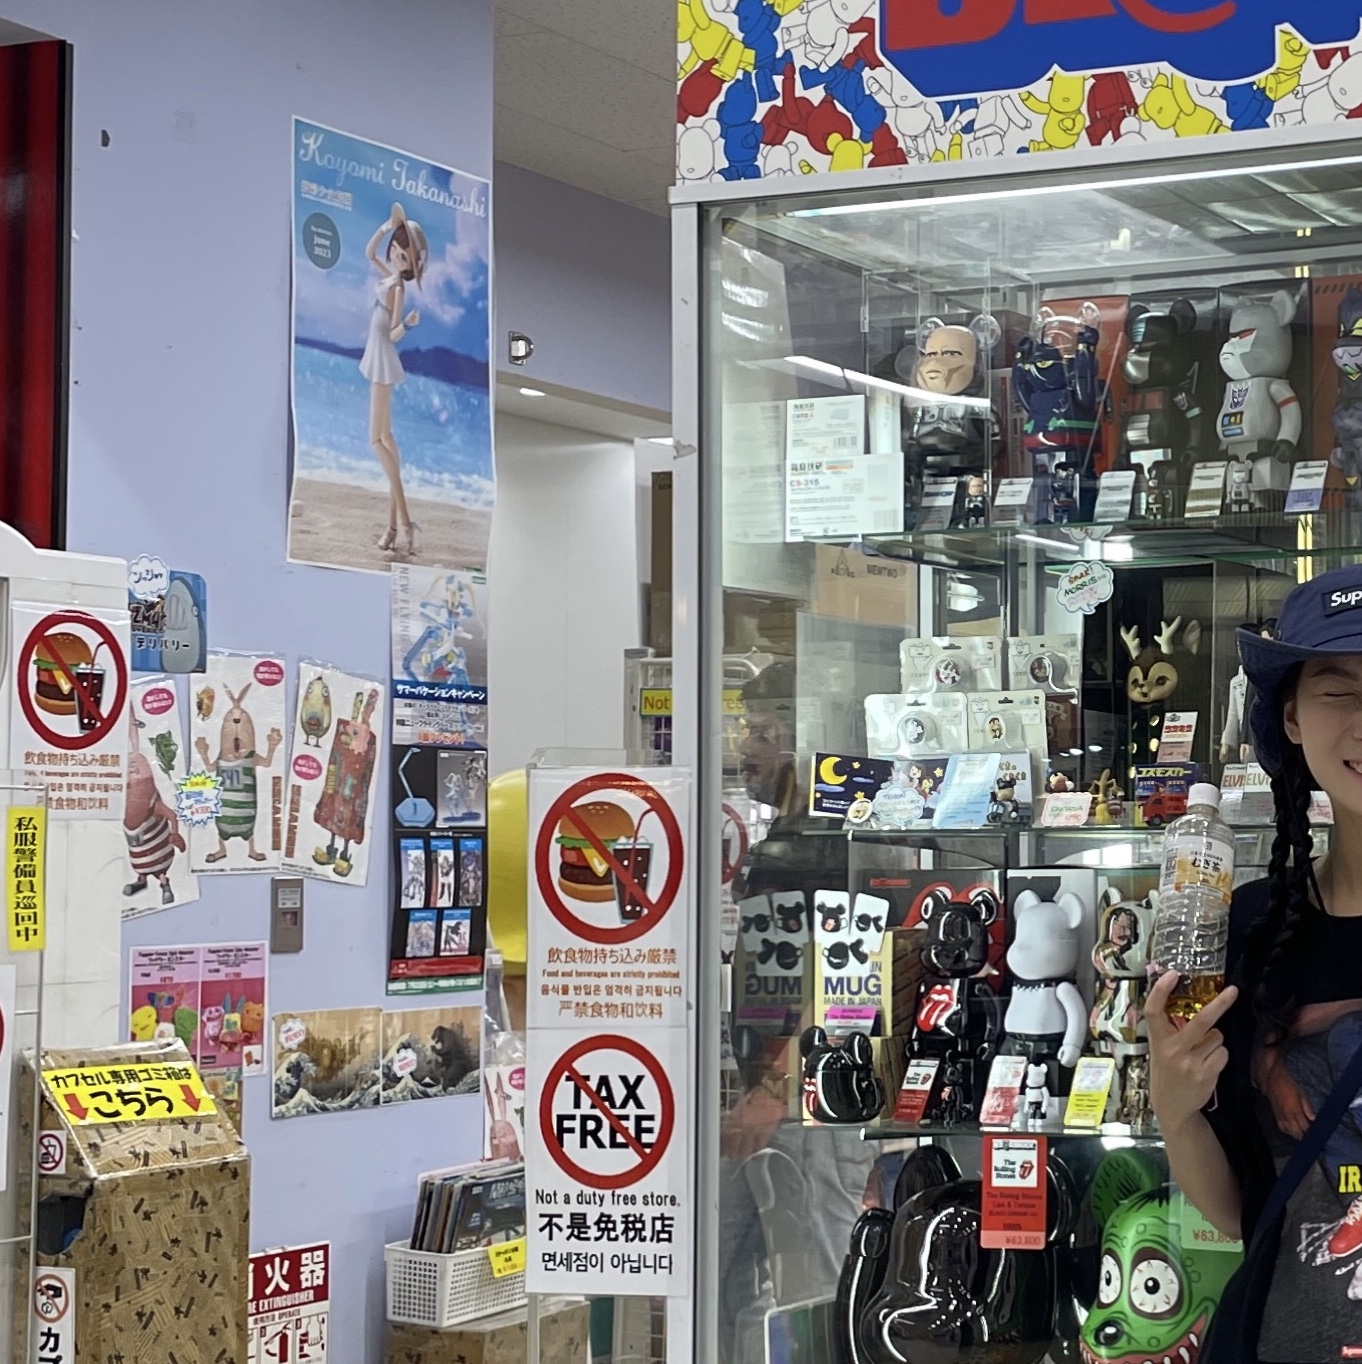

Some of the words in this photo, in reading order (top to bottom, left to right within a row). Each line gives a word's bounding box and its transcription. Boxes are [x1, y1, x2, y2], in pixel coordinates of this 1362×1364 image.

[299, 132, 384, 186] Koyomi
[391, 158, 487, 217] Takanashi
[644, 696, 672, 710] Not
[14, 816, 38, 942] 私服警備員巡回中
[547, 947, 677, 965] 飲食物持ち込み厳禁
[542, 969, 559, 978] Food
[561, 970, 573, 978] and
[575, 969, 608, 979] beverages
[623, 970, 645, 979] strictly
[648, 970, 680, 979] prohibited
[541, 984, 570, 996] 음식물
[573, 984, 602, 996] 반입은
[605, 984, 632, 997] 엄격히
[635, 985, 682, 997] 금지됩니다
[824, 975, 882, 996] MUG
[558, 1000, 663, 1019] 严禁食物和饮料
[824, 997, 846, 1006] MADE
[848, 997, 856, 1006] IN
[858, 997, 882, 1006] JAPAN
[565, 1074, 646, 1110] TAX
[88, 1087, 174, 1119] こちら
[556, 1113, 656, 1149] FREE
[994, 1166, 1016, 1174] Rolling
[1004, 1158, 1016, 1166] The
[535, 1189, 558, 1205] Not
[563, 1193, 571, 1205] a
[576, 1190, 605, 1207] duty
[611, 1191, 637, 1206] free
[642, 1191, 681, 1207] store.
[538, 1212, 675, 1244] 不是免税店
[1005, 1235, 1041, 1245] ¥63,800
[541, 1252, 604, 1273] 면세점이
[610, 1252, 673, 1275] 아닙니다
[259, 1289, 315, 1312] EXTINGUISHER
